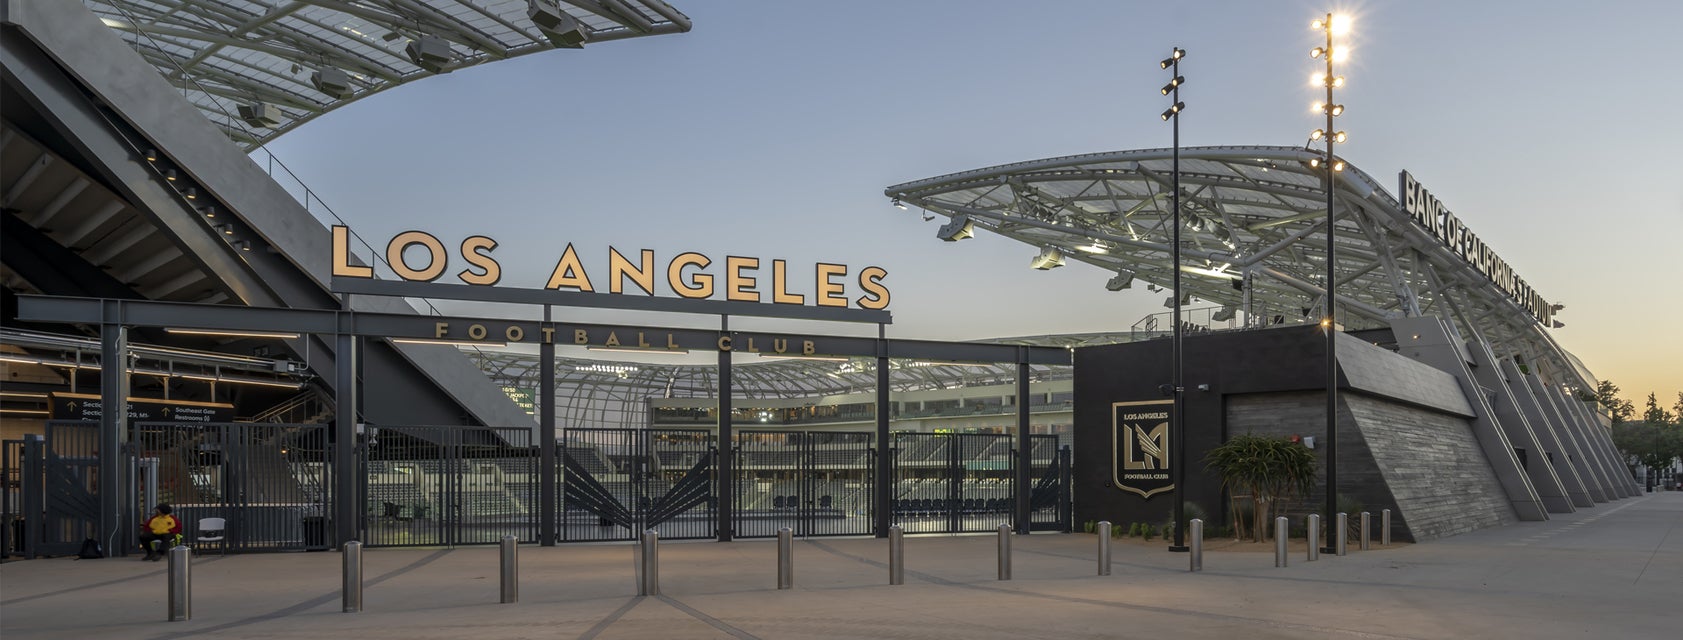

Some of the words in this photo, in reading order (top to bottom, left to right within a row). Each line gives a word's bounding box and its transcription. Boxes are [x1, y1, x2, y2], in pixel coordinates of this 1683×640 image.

[331, 224, 502, 286] LOS
[544, 241, 891, 311] ANGELES
[1402, 169, 1445, 241] BANC
[1445, 210, 1464, 256] OF
[1463, 227, 1517, 298] CALIFORNIA
[435, 321, 679, 349] FOOTBALL
[718, 336, 816, 355] CLUB
